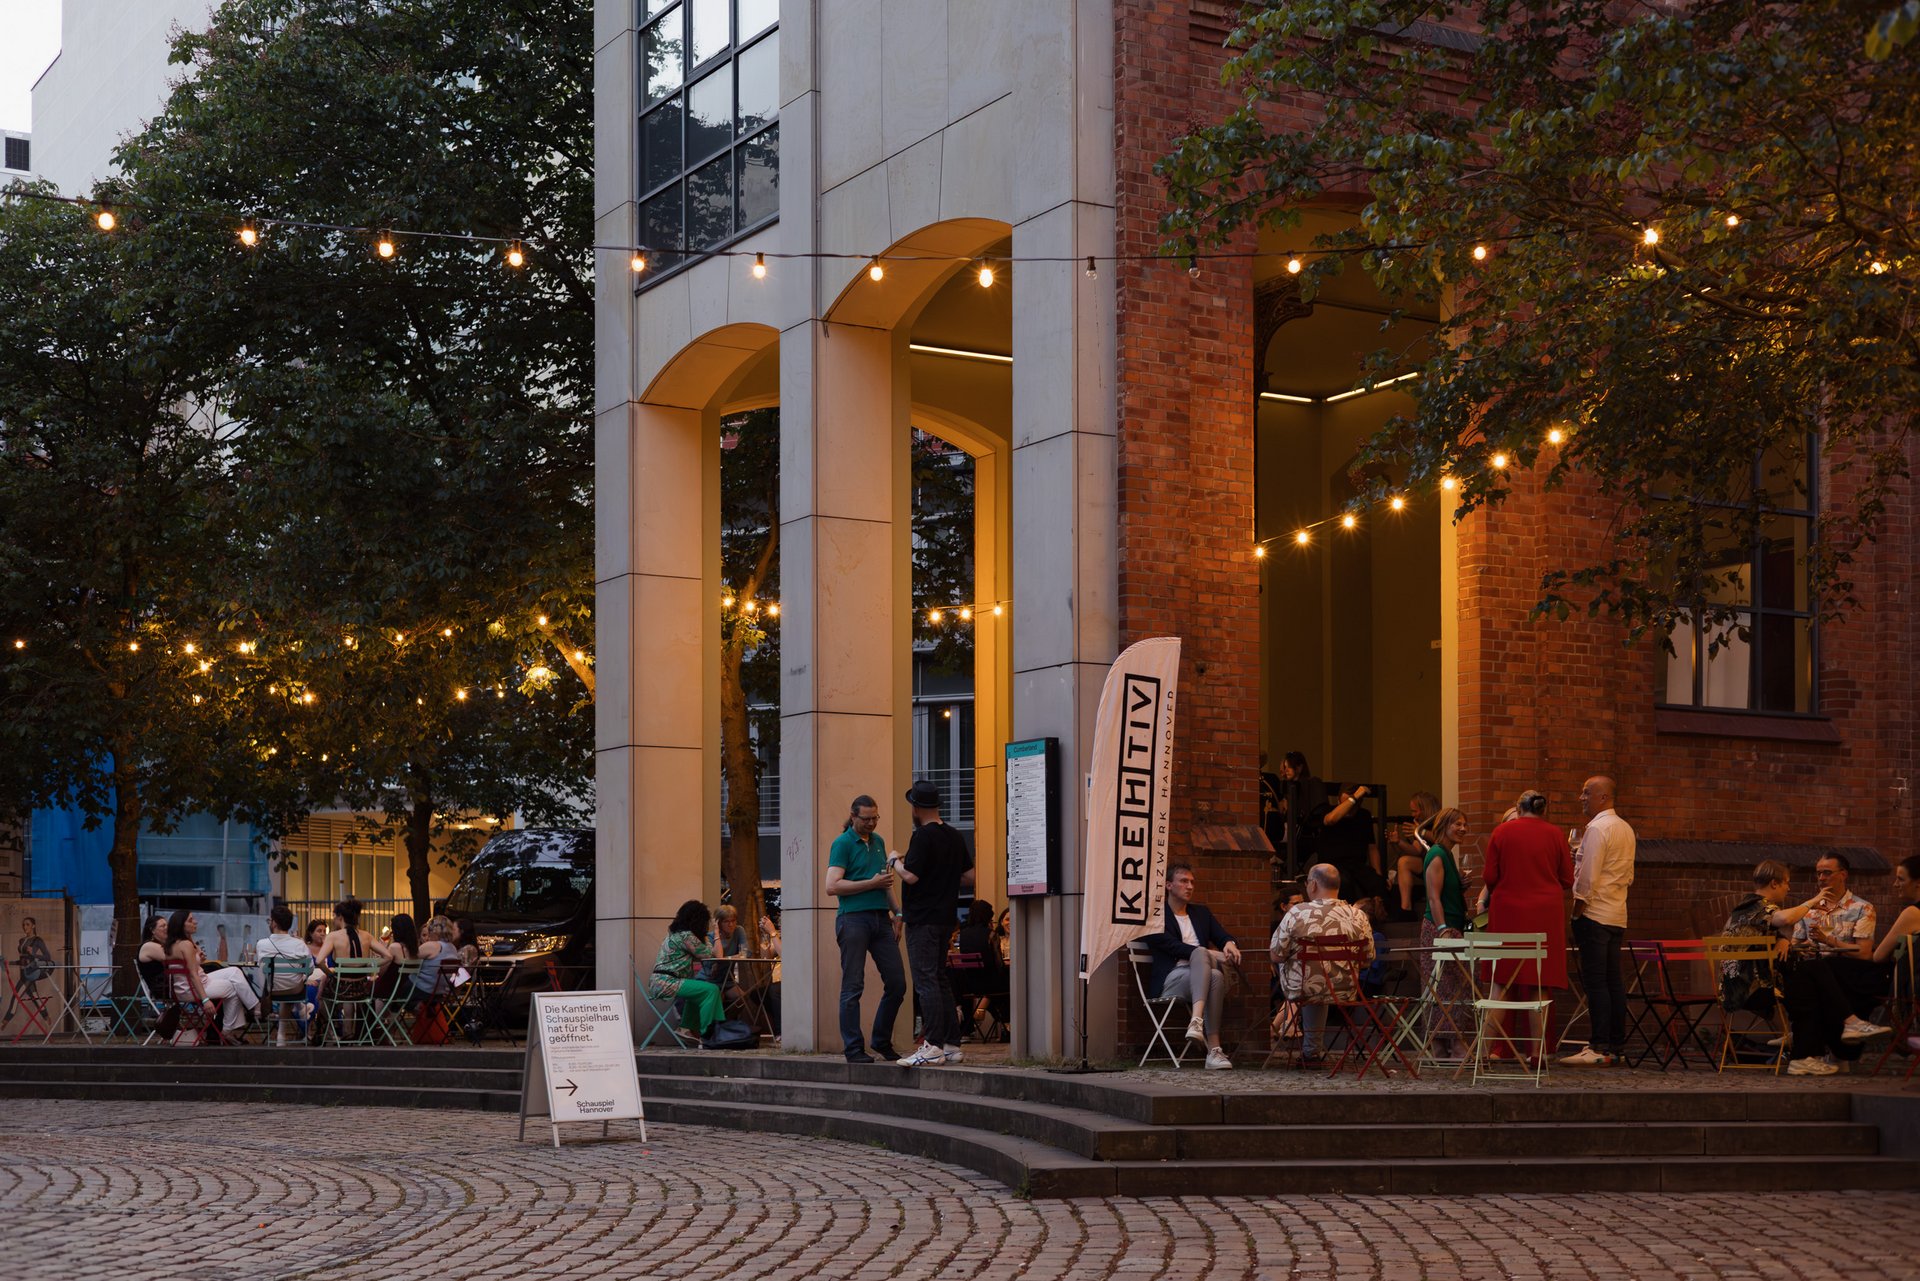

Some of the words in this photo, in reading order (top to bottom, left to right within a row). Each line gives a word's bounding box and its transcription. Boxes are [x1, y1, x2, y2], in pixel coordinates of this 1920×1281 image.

[1119, 685, 1152, 915] KREHTIV
[1153, 811, 1167, 917] NETZWERK
[545, 1005, 560, 1014] Die
[561, 1004, 598, 1014] Kantine
[599, 1003, 611, 1012] im
[545, 1013, 620, 1024] Schauspielhaus
[547, 1024, 563, 1033] hat
[564, 1023, 578, 1033] für
[579, 1023, 595, 1032] Sie
[548, 1033, 593, 1045] geöffnet.
[576, 1099, 615, 1108] Schauspiel
